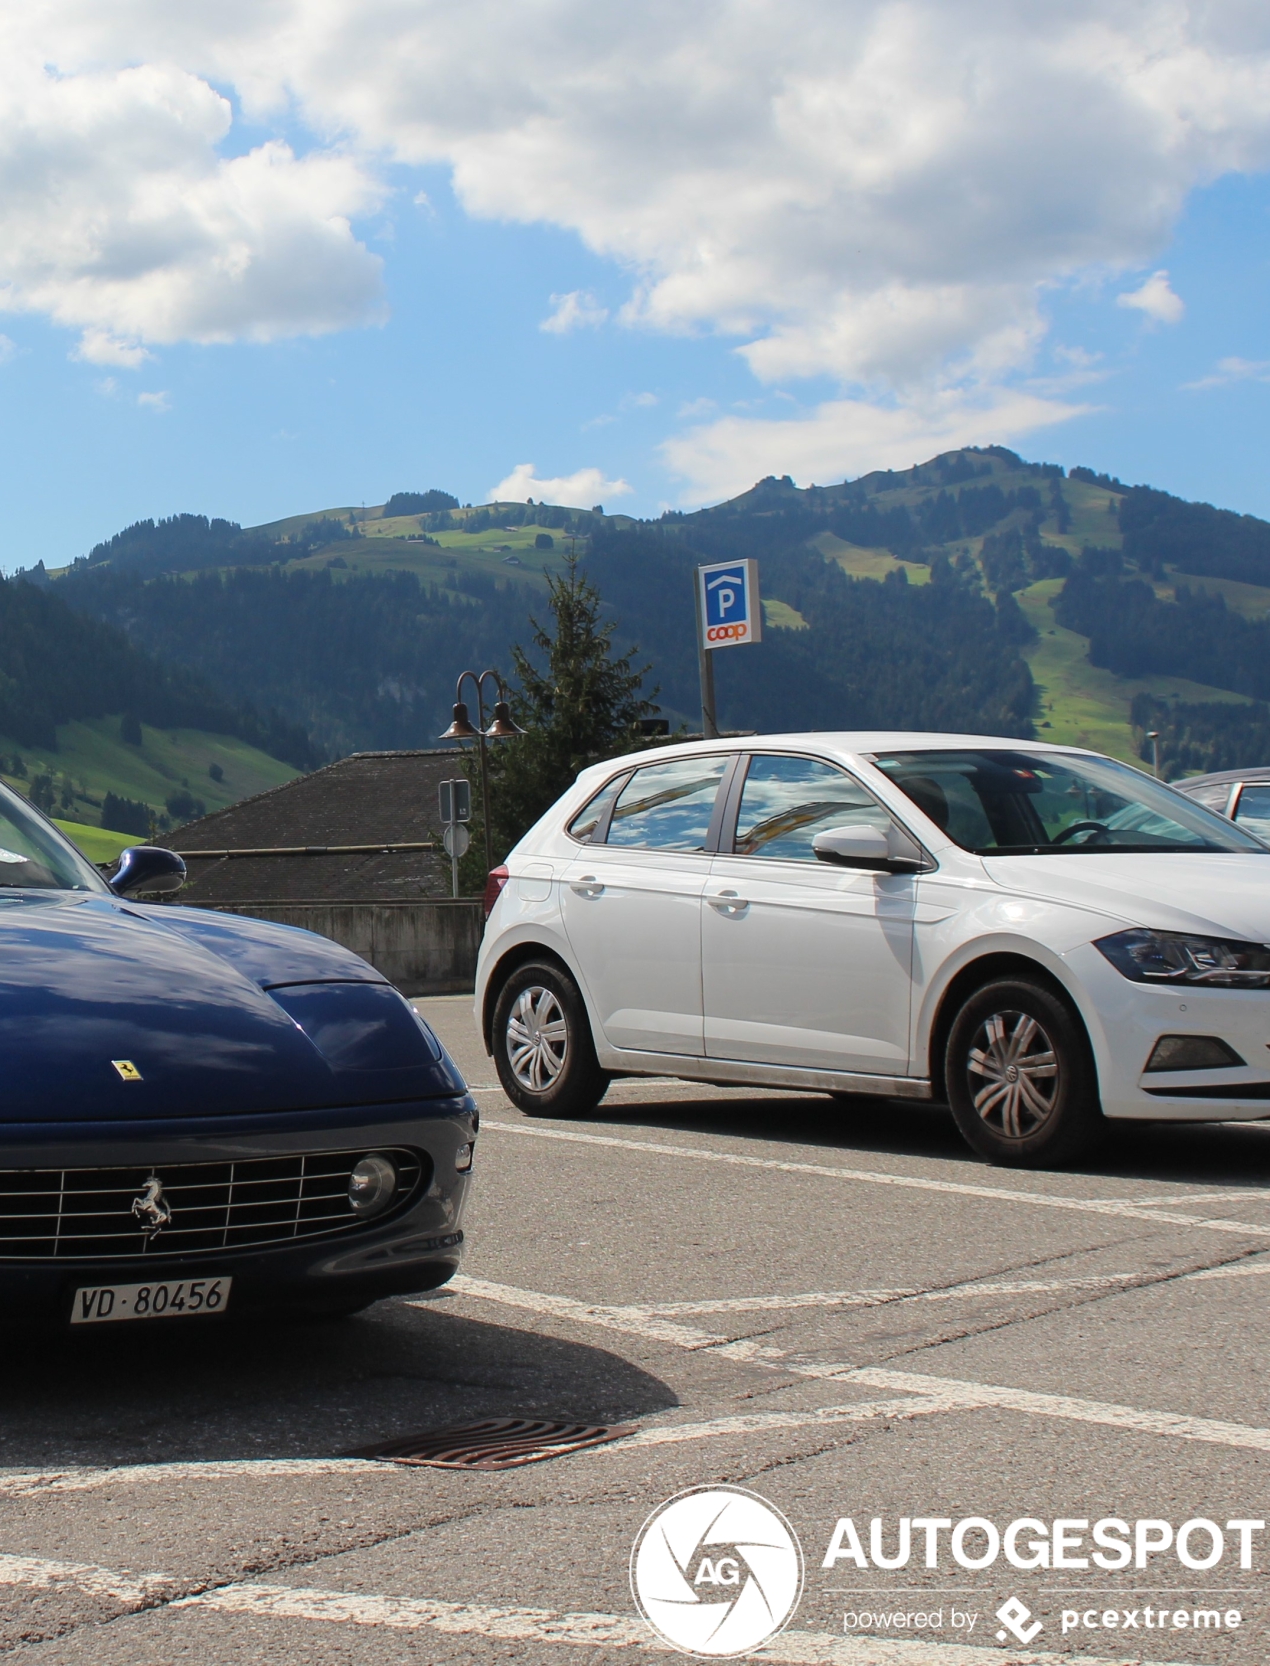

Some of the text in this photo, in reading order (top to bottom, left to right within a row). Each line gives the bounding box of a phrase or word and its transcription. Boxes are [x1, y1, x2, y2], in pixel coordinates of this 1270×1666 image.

[718, 588, 735, 618] P
[707, 623, 748, 642] coop
[133, 1279, 223, 1315] 80456
